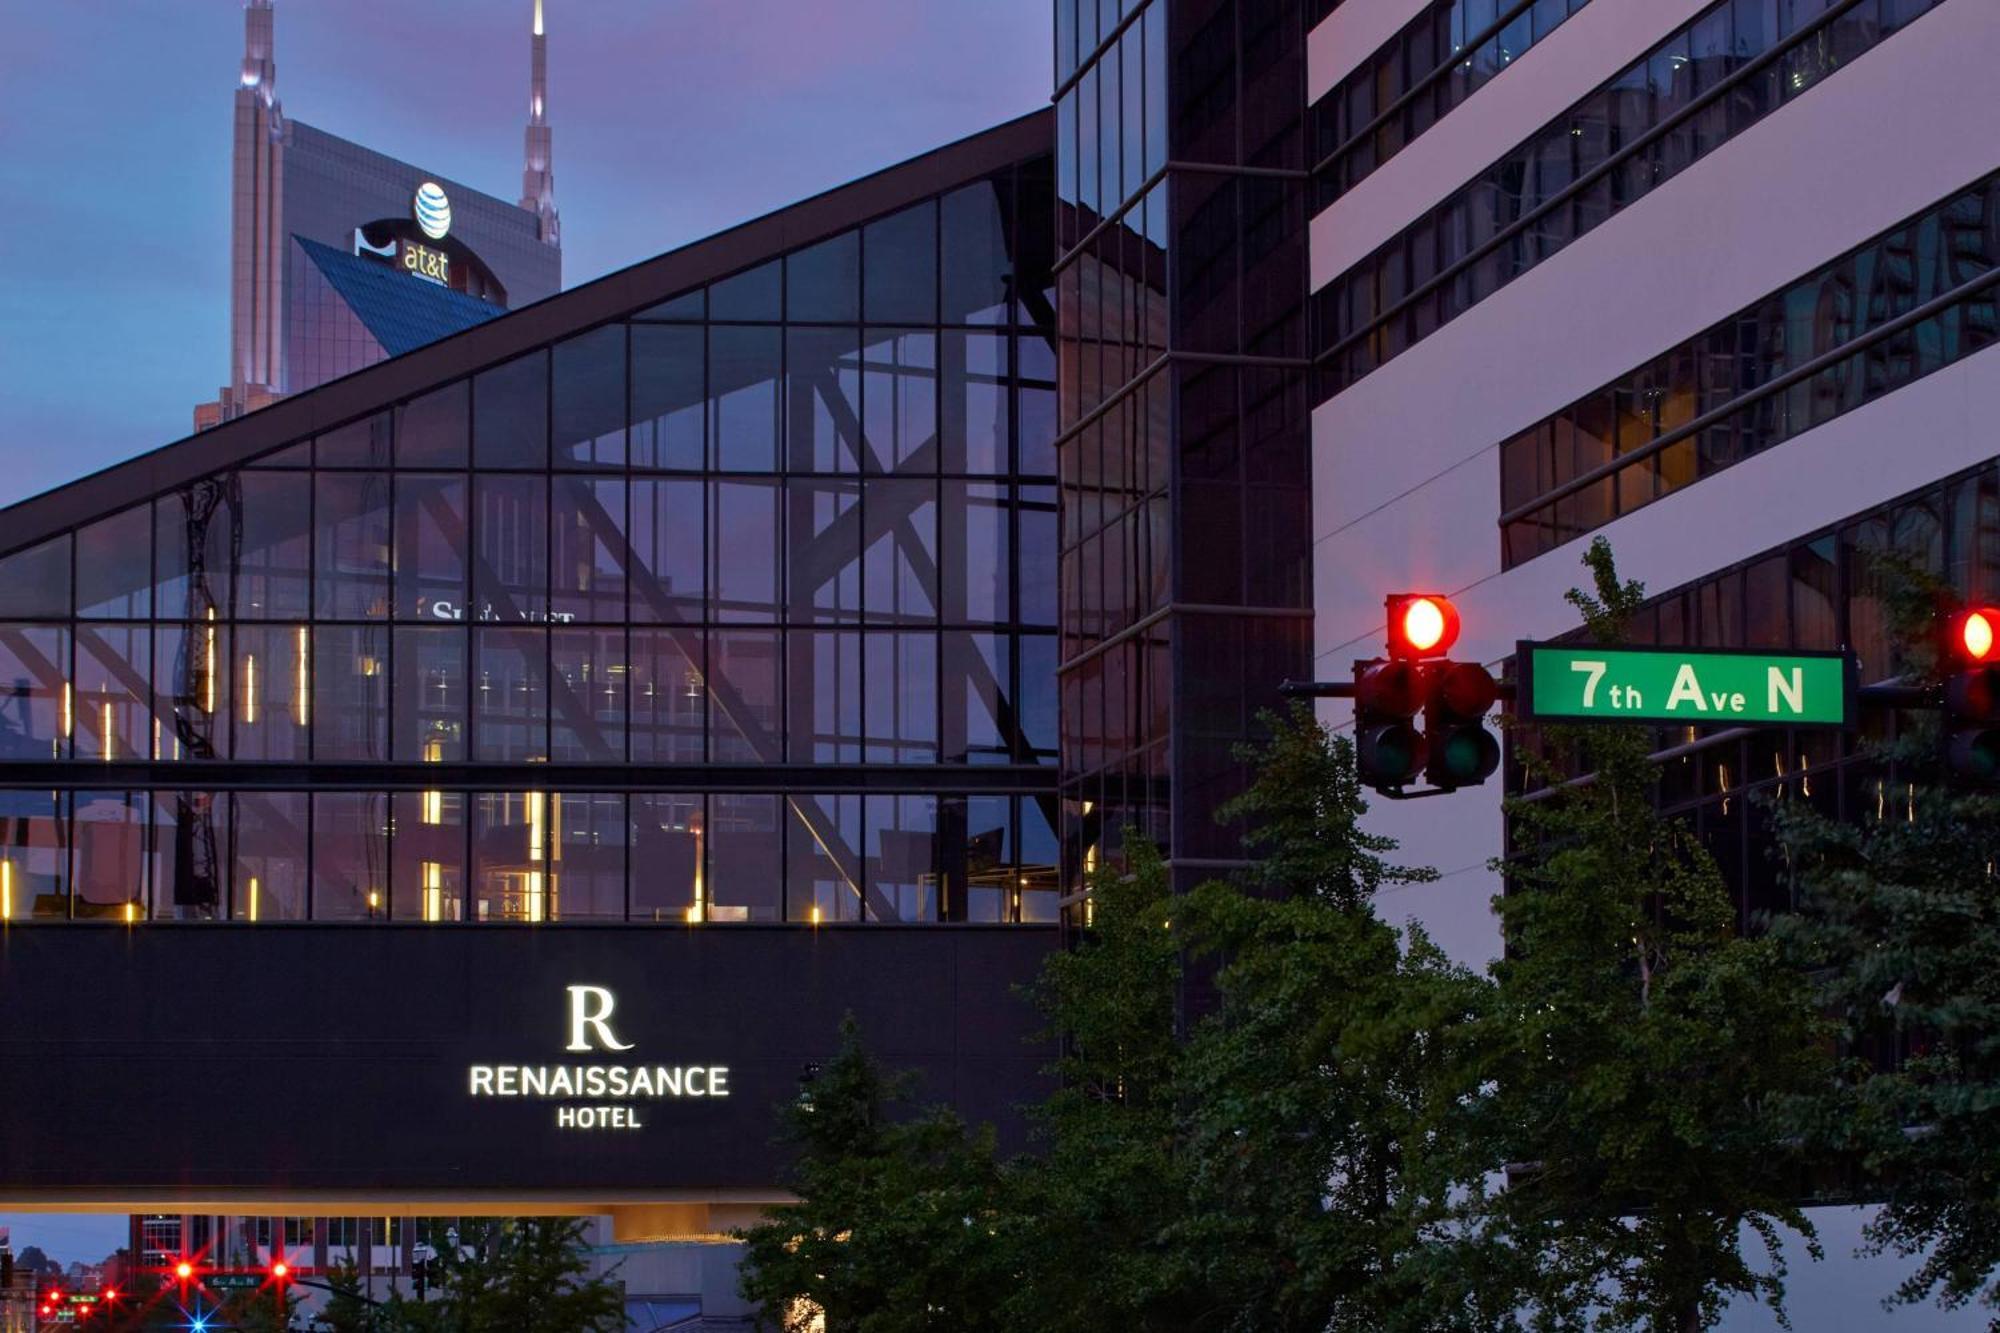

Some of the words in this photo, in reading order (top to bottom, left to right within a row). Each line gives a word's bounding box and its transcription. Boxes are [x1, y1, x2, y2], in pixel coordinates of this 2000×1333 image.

[405, 245, 449, 281] at&t
[1571, 661, 1642, 708] 7th
[1666, 664, 1746, 711] Ave
[1768, 667, 1803, 713] N
[566, 985, 635, 1051] R
[469, 1065, 730, 1096] RENAISSANCE
[558, 1106, 642, 1128] HOTEL
